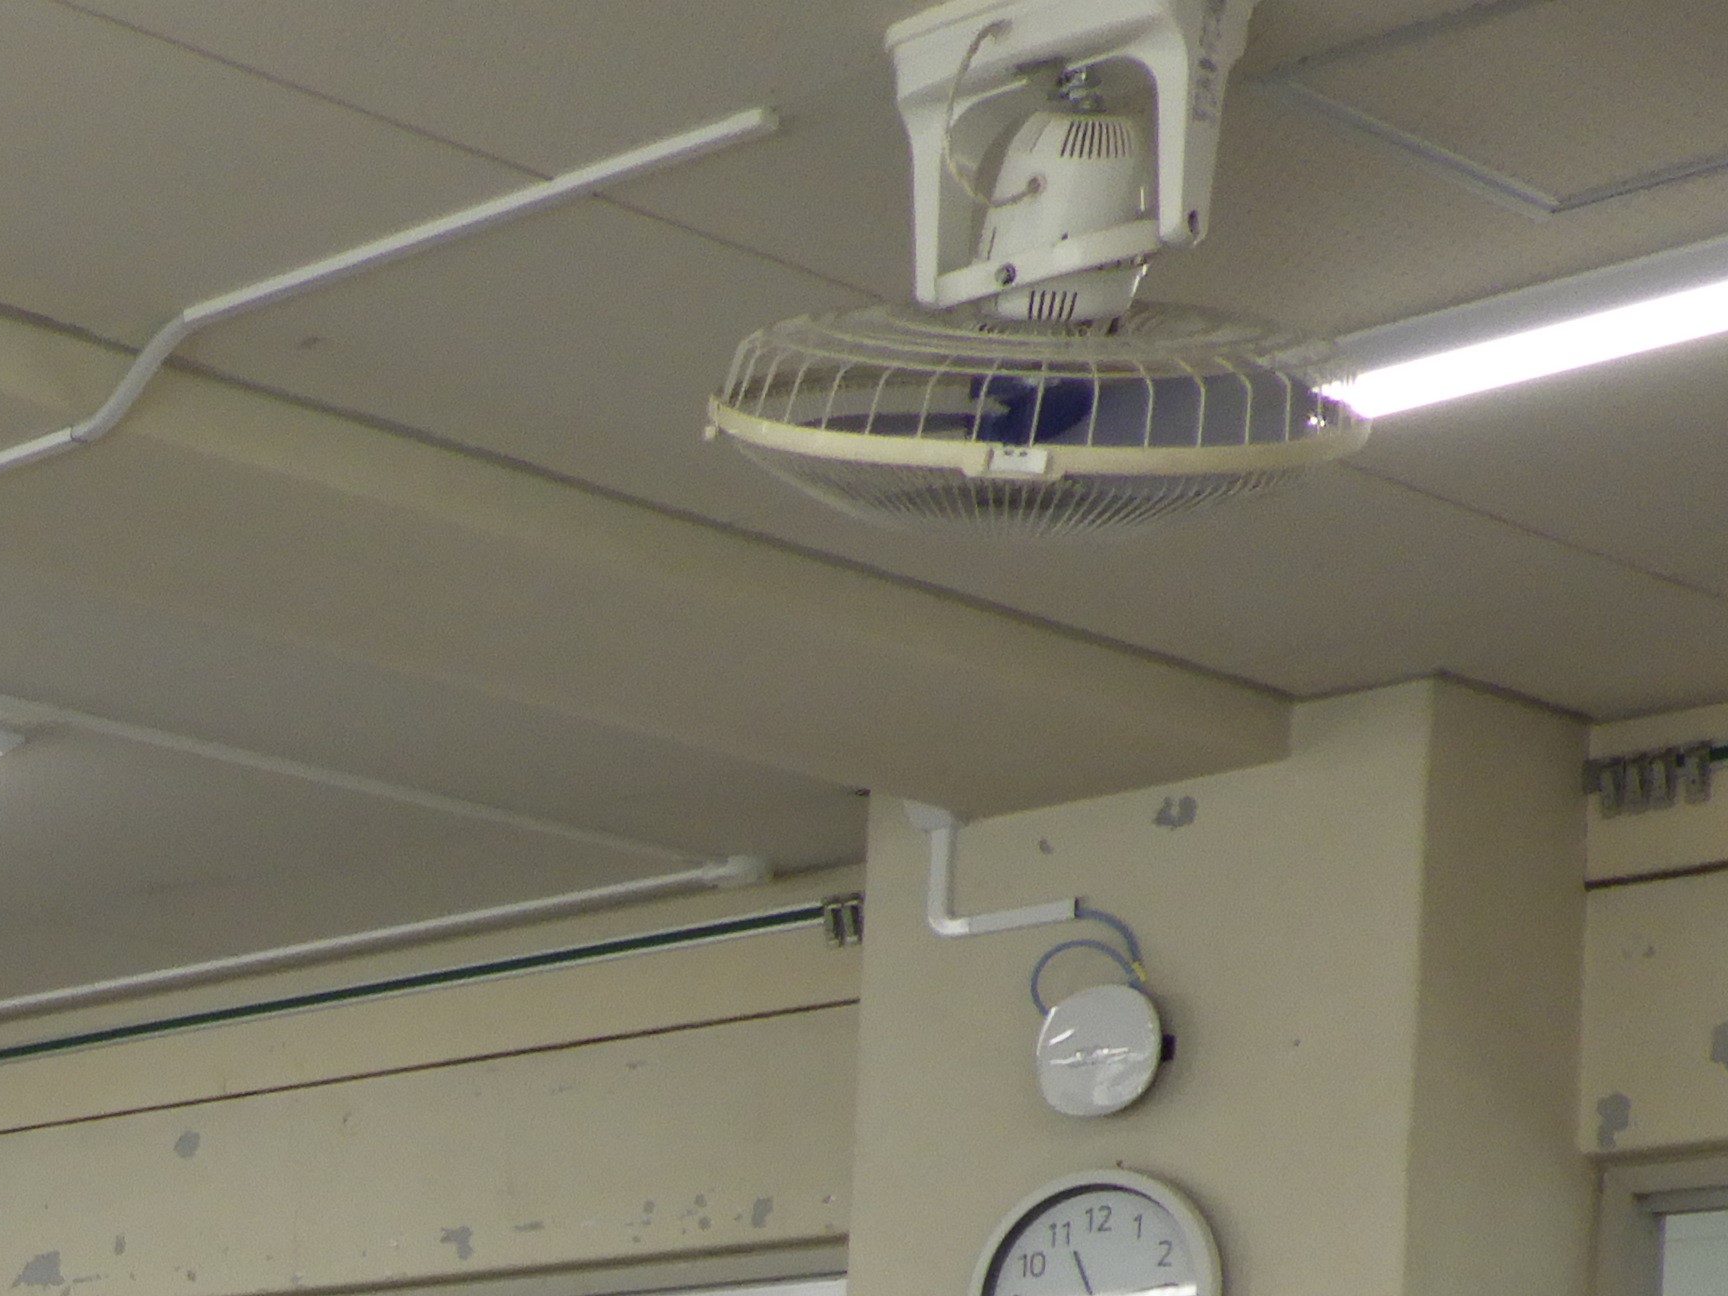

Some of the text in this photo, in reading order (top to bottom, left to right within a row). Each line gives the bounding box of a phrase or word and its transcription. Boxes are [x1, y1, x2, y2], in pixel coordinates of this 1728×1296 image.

[1085, 1205, 1112, 1233] 12
[1134, 1214, 1143, 1240] 1
[1049, 1221, 1072, 1248] 11
[1018, 1252, 1046, 1278] 10
[1157, 1240, 1172, 1267] 2
